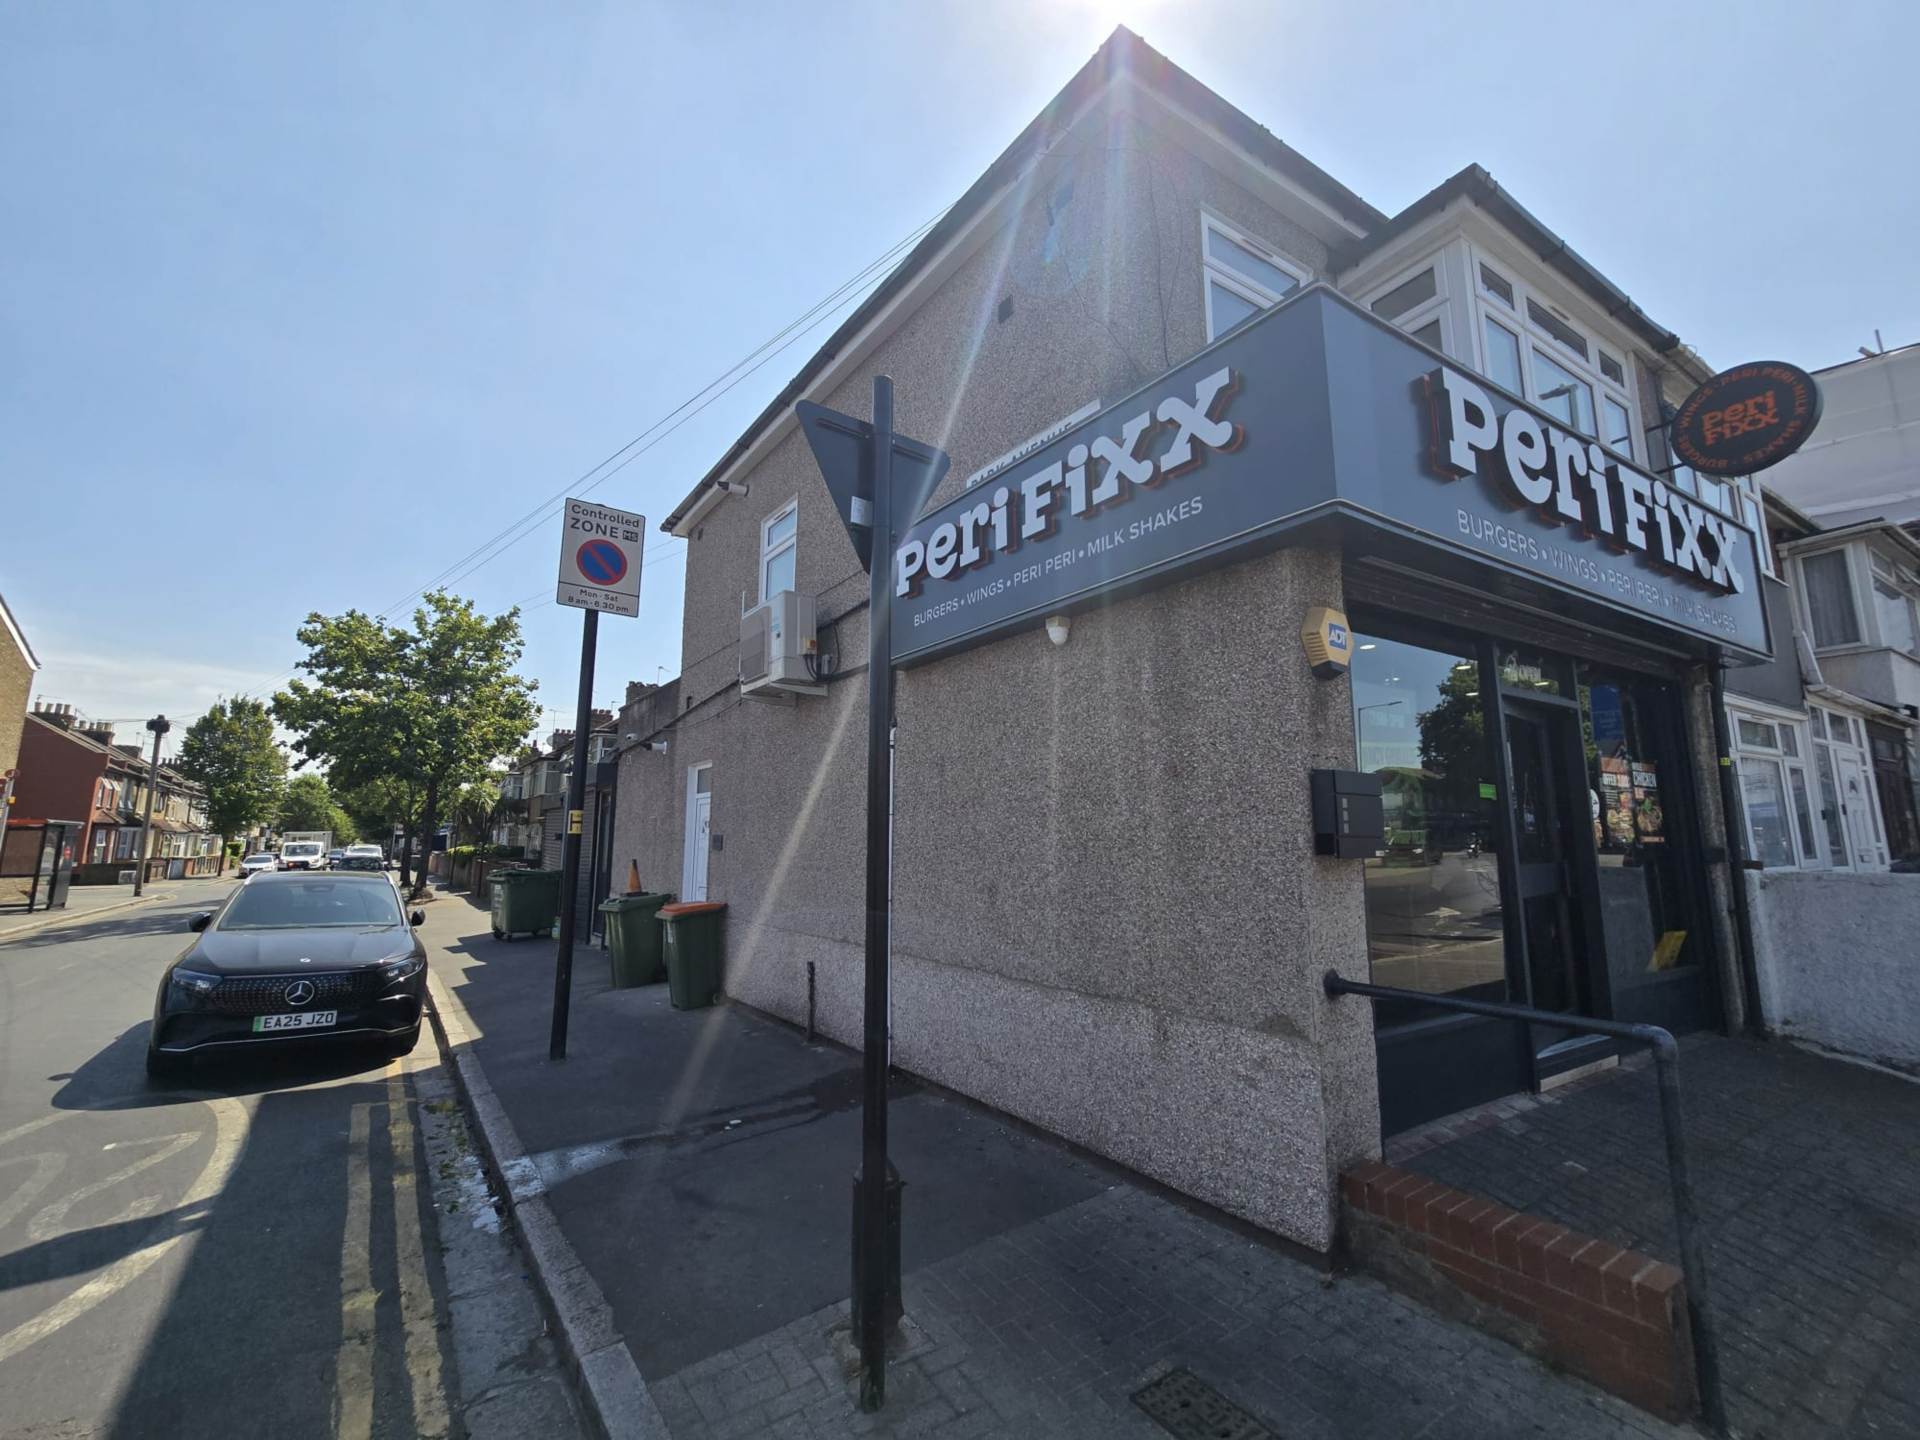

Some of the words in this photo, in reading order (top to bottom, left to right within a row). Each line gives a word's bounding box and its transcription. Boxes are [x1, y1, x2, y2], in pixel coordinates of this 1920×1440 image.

[571, 504, 639, 528] Controlled
[570, 517, 619, 539] ZONE
[914, 598, 959, 627] BURGERS
[966, 579, 1004, 605] WINGS
[1014, 564, 1041, 587] PERI
[1045, 549, 1075, 575] PERI
[1087, 528, 1125, 557] MILK
[1129, 496, 1203, 540] SHAKES
[1457, 509, 1538, 560] BURGERS
[1550, 545, 1598, 582] WINGS
[1608, 569, 1637, 598] PERI
[580, 589, 597, 598] Mon
[604, 593, 618, 602] Sat
[1329, 626, 1346, 646] ADT
[263, 1014, 303, 1029] EA25
[306, 1012, 334, 1025] JZO
